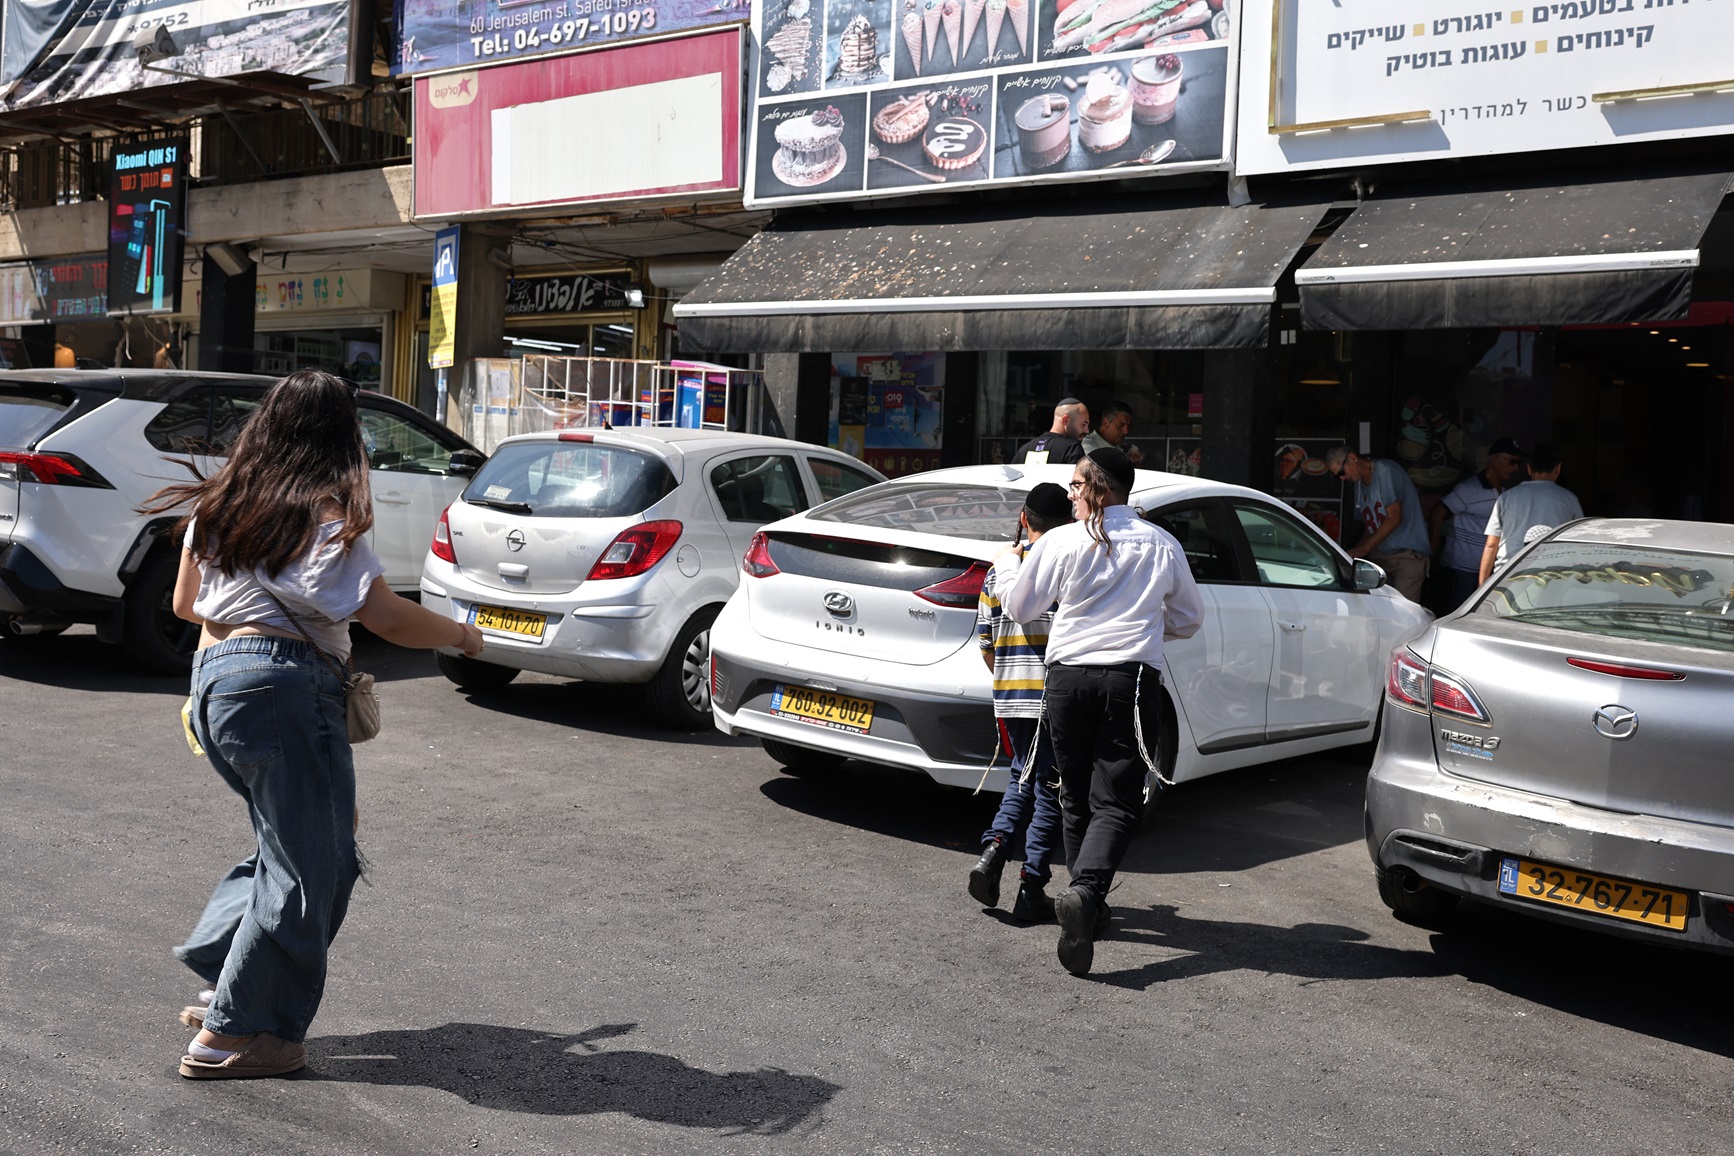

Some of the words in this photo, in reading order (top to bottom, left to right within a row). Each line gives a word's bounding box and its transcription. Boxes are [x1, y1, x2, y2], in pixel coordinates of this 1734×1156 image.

[470, 16, 484, 34] 60
[487, 7, 552, 32] Jerusalem
[556, 4, 571, 18] st.
[575, 0, 612, 16] Safed
[1532, 0, 1634, 23] בטעמים
[470, 36, 509, 57] Tel:
[514, 7, 656, 49] 04-697-1093
[1432, 12, 1502, 37] יוגורט
[1327, 24, 1405, 50] שייקים
[1557, 24, 1655, 53] קינוחים
[1385, 51, 1453, 77] בוטיק
[1460, 40, 1527, 66] עוגות
[435, 85, 458, 100] סלקום
[1542, 95, 1588, 113] כשר
[1439, 98, 1528, 125] למהדרין
[115, 151, 147, 170] Xiaomi
[148, 148, 165, 166] QIN
[165, 146, 177, 163] S1
[120, 174, 137, 191] כשר
[139, 171, 159, 193] תומך
[908, 607, 934, 620] hybrid
[816, 620, 865, 637] IONIQ
